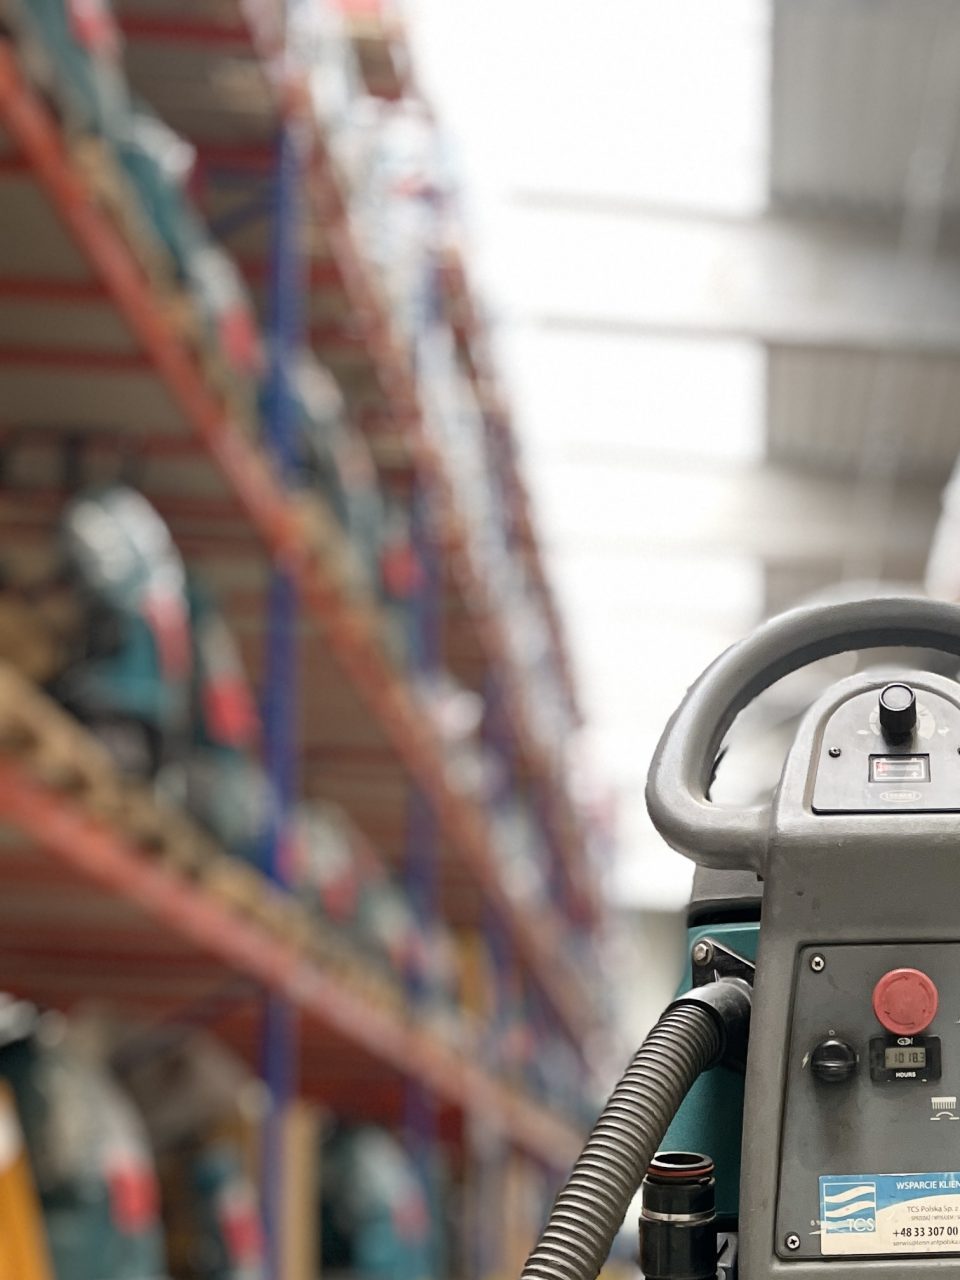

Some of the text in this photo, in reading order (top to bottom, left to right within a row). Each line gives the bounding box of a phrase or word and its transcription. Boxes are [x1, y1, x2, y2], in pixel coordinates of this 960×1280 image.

[896, 1180, 937, 1190] WSPARCIE
[907, 1205, 919, 1213] TCS
[921, 1204, 942, 1213] Polska
[846, 1218, 875, 1232] TCS
[893, 1227, 912, 1237] +48
[914, 1227, 925, 1237] 33
[927, 1226, 945, 1237] 307
[946, 1226, 959, 1236] 00
